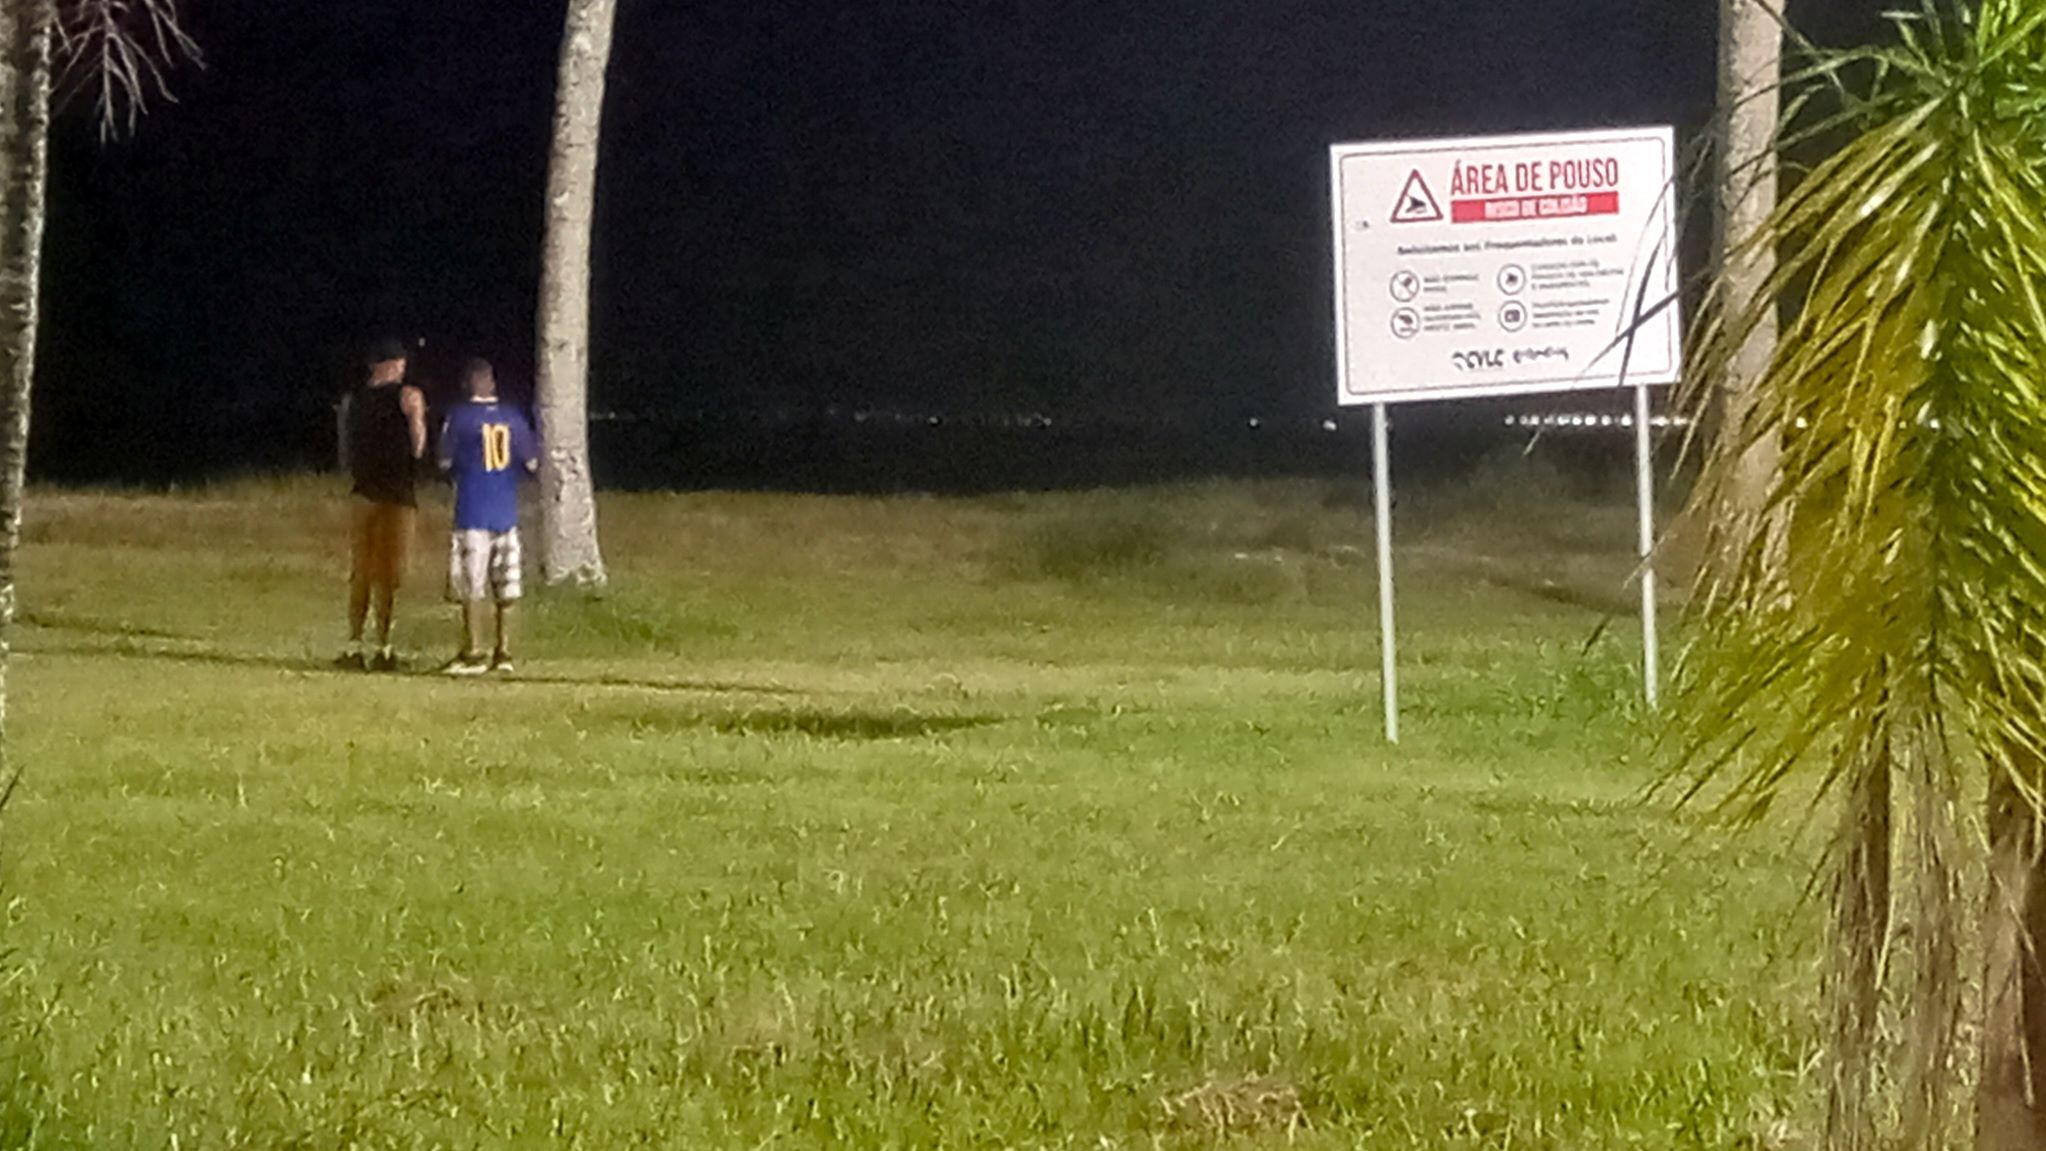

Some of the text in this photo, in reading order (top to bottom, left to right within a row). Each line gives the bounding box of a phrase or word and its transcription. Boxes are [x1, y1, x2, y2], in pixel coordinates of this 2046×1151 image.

[1450, 157, 1619, 196] ÁREA DE POUSO
[482, 423, 510, 472] 10
